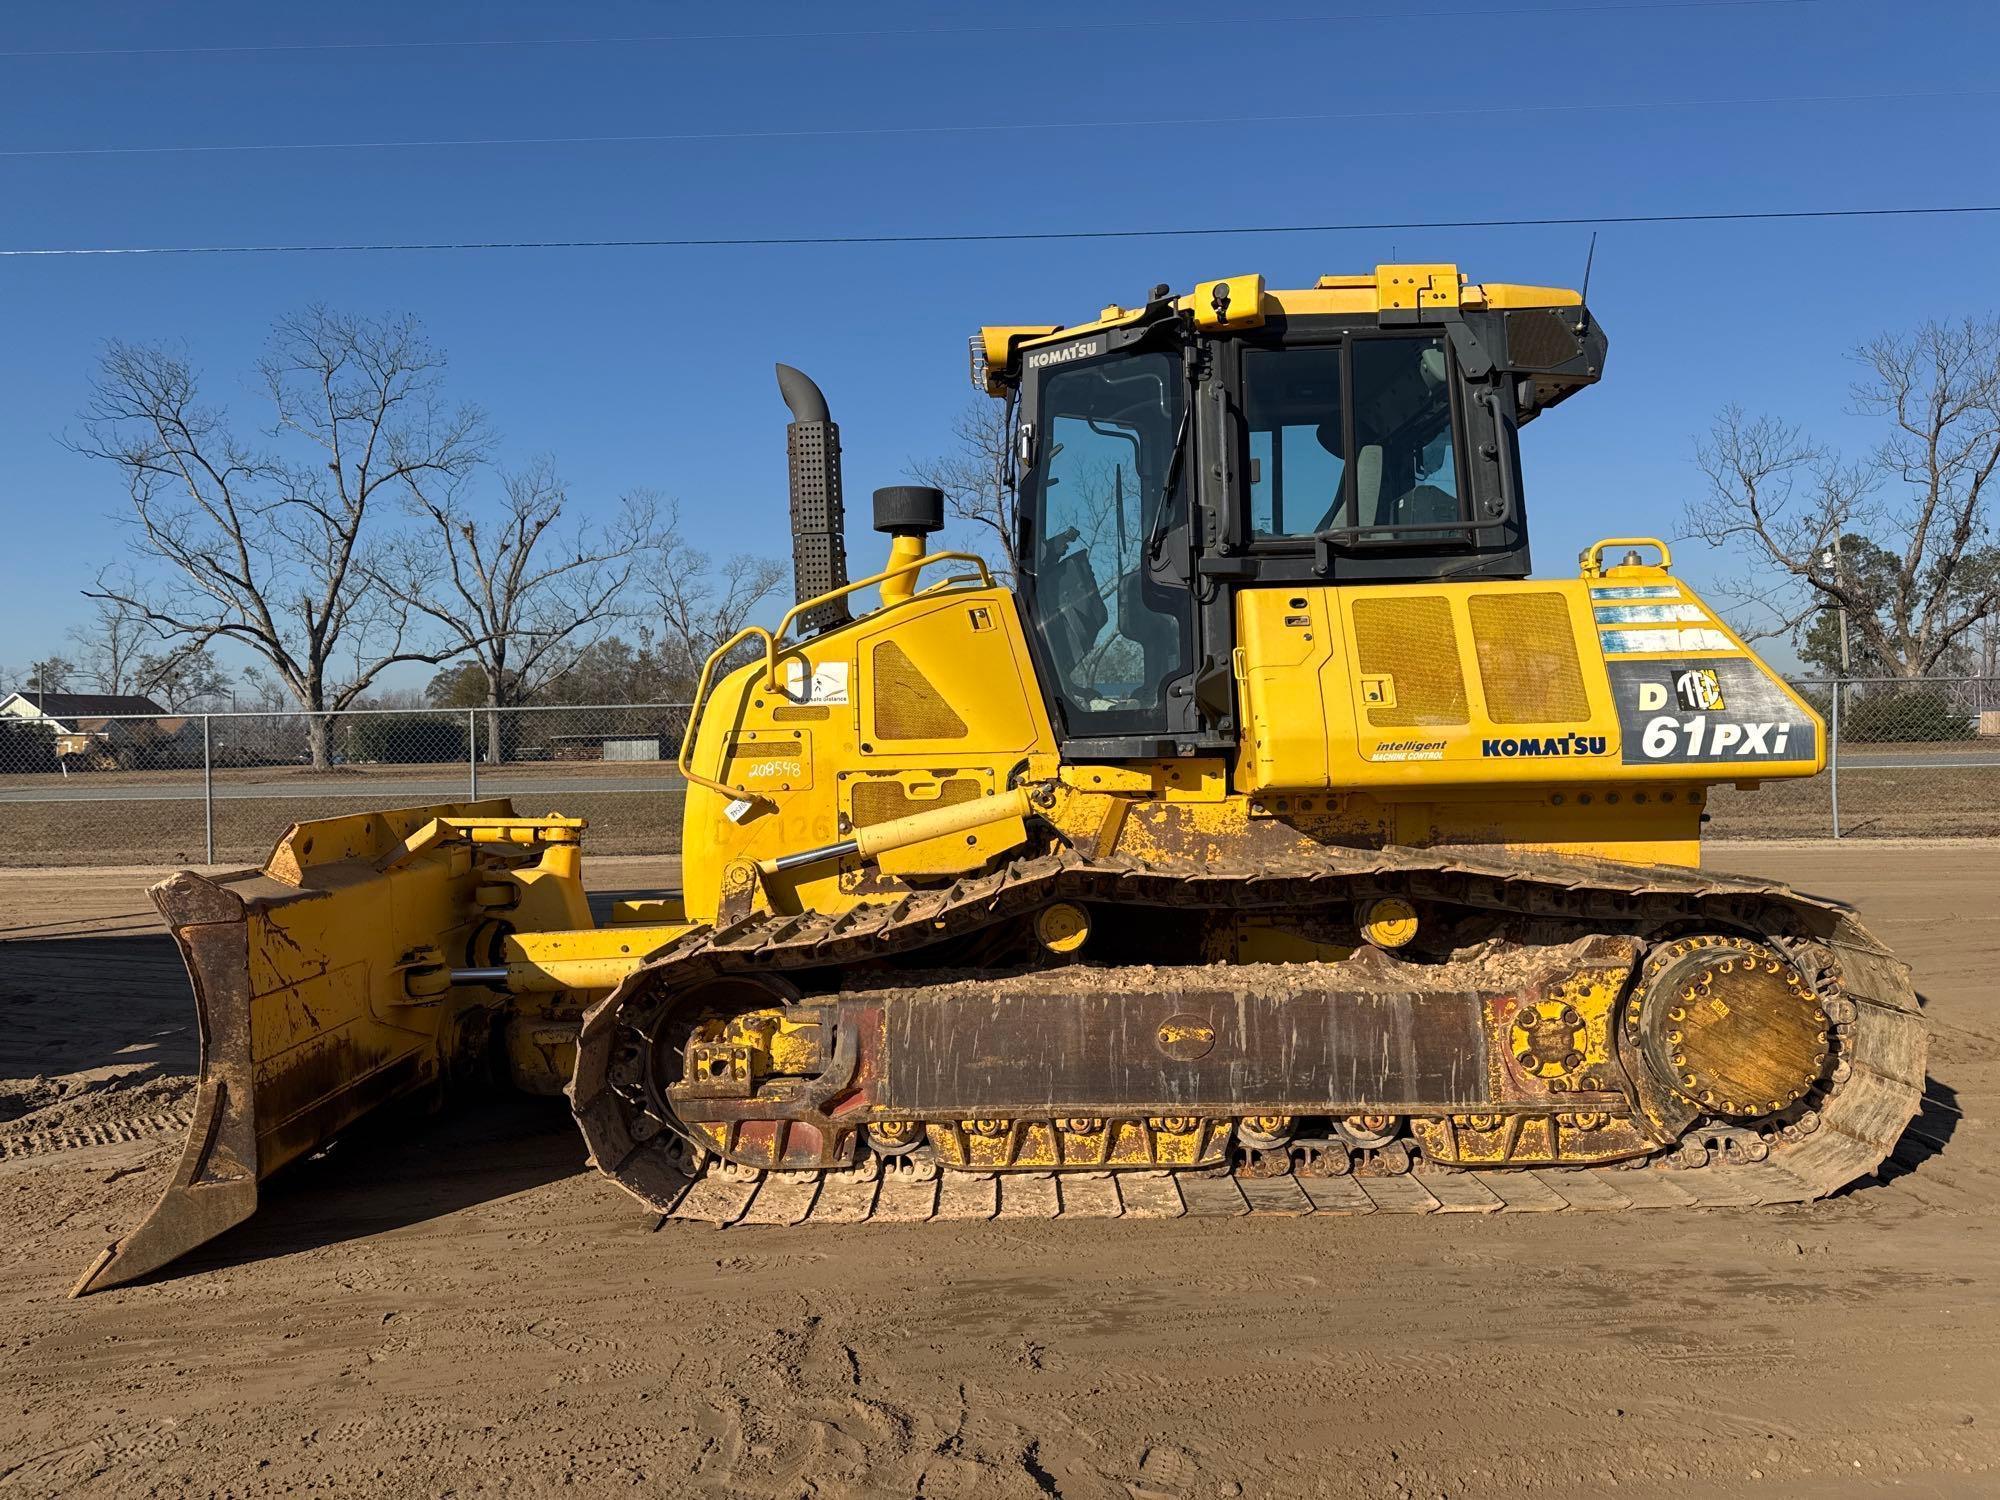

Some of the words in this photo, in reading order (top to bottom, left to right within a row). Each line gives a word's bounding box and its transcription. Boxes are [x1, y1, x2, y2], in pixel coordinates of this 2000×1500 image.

[1028, 342, 1097, 368] KOMATSU
[1638, 682, 1668, 711] D
[1376, 740, 1447, 752] intelligent
[1482, 732, 1606, 757] KOMATSU
[1371, 753, 1407, 761] MACHINE
[1407, 751, 1443, 760] CONTROL
[748, 761, 801, 778] 208548
